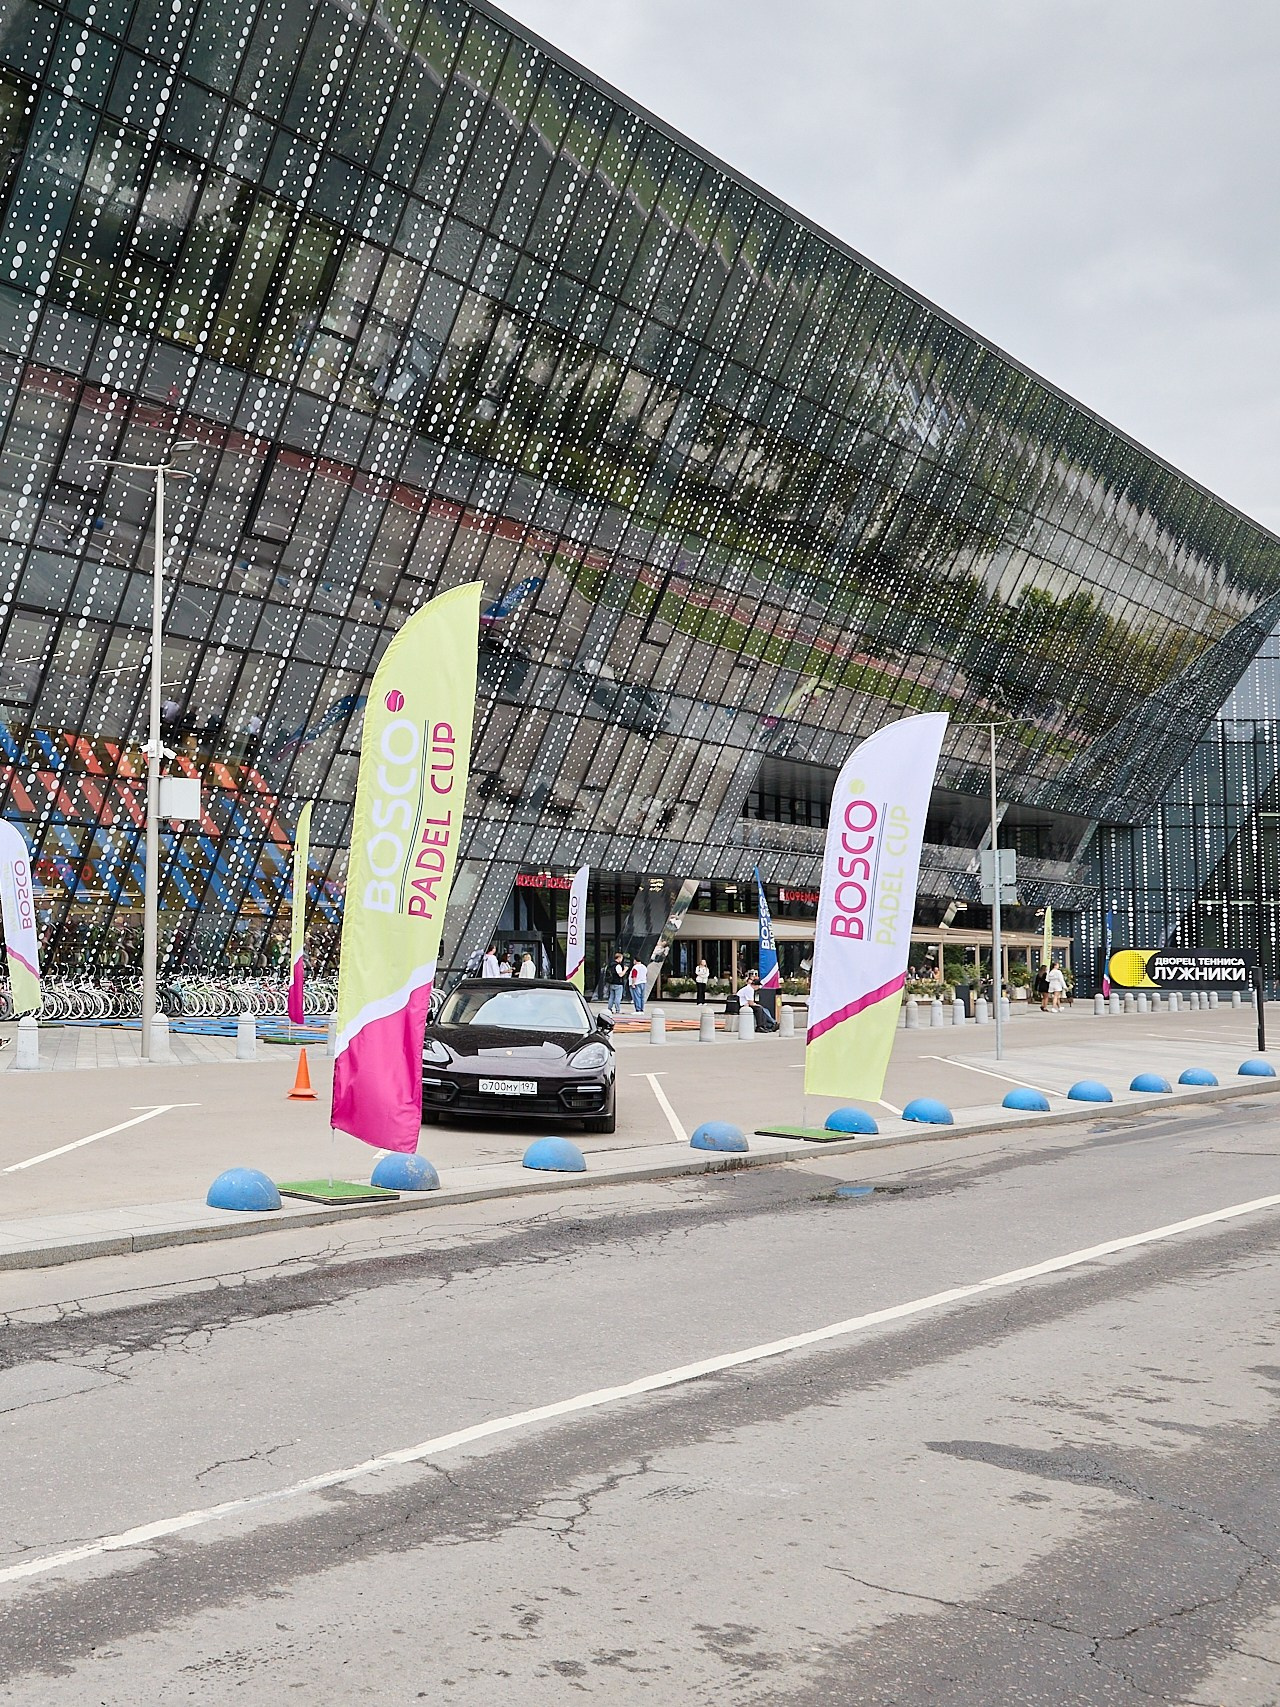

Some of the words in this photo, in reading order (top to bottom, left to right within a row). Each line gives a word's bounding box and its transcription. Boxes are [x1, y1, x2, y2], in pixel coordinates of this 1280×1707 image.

[363, 718, 420, 914] BOSCO
[407, 810, 452, 920] PADEL
[430, 722, 456, 794] CUP
[885, 805, 912, 857] CUP
[830, 800, 878, 941] BOSCO
[569, 896, 578, 946] BOSCO
[759, 896, 770, 950] BOSCO
[875, 867, 904, 946] PADEL
[1152, 967, 1246, 981] ЛУЖНИКИ
[1154, 958, 1196, 967] ДВОРЕЦ
[1198, 957, 1246, 966] ТЕННИСА
[521, 1082, 535, 1090] 197
